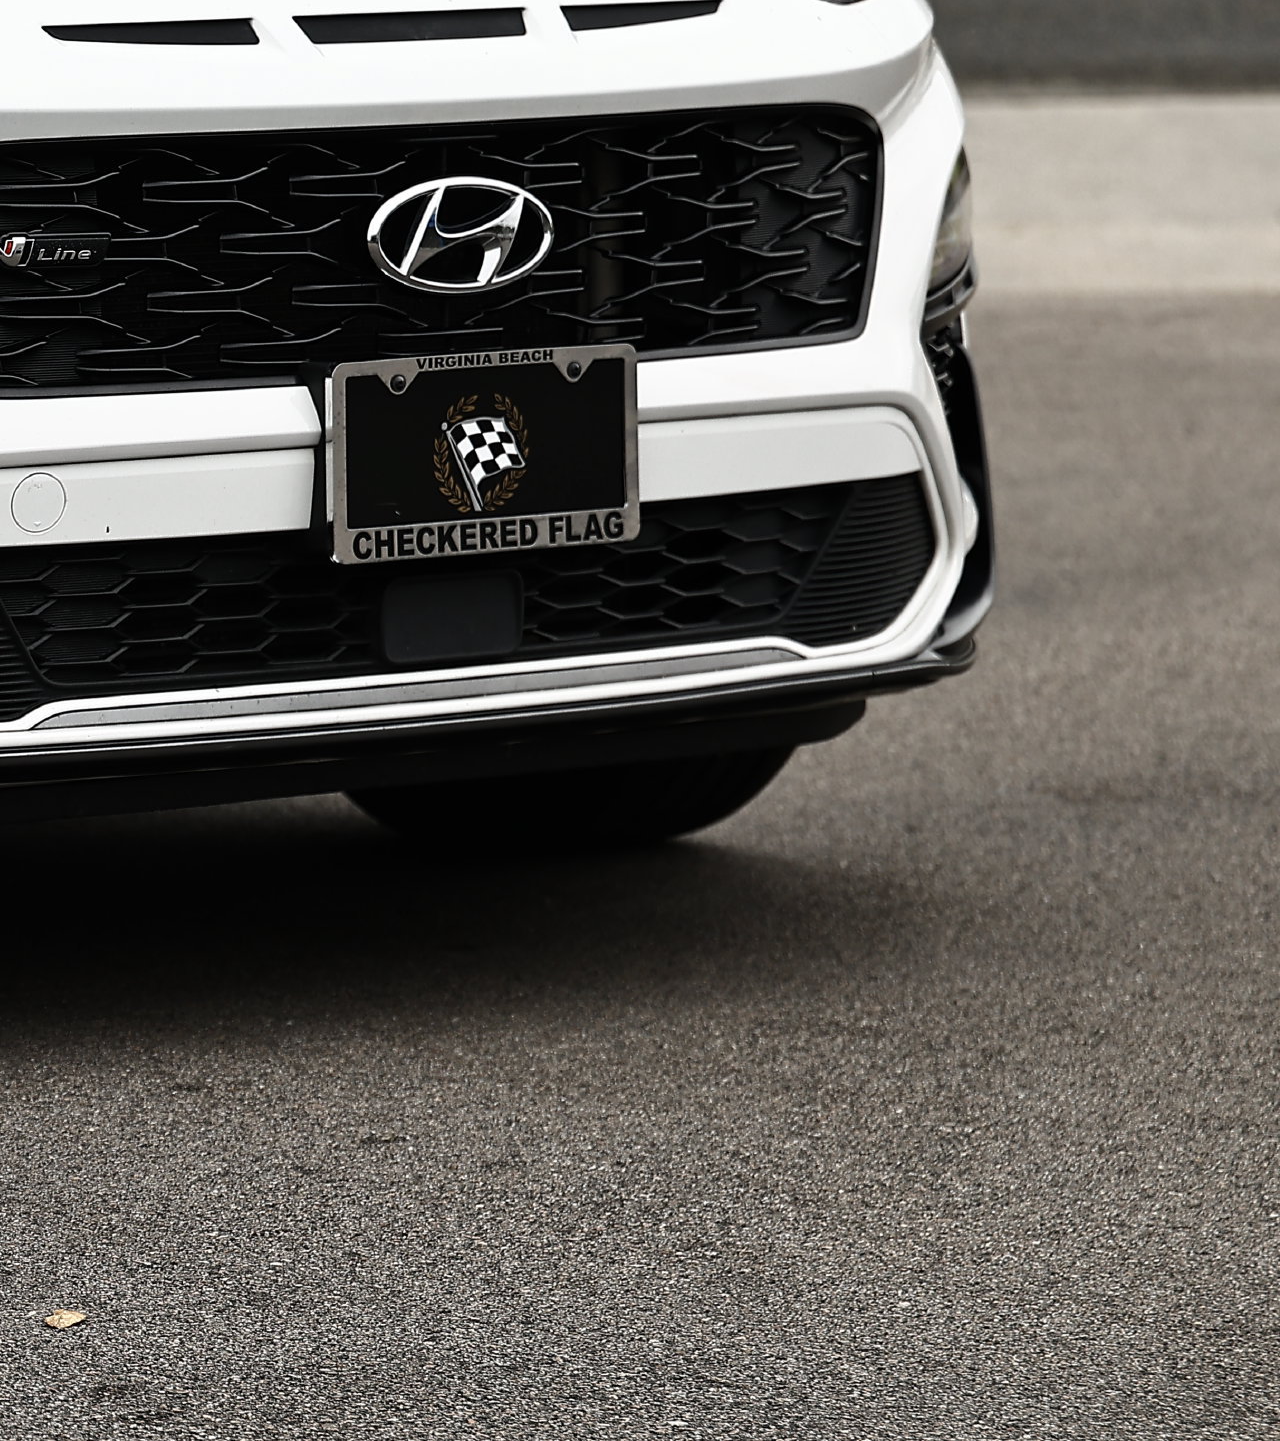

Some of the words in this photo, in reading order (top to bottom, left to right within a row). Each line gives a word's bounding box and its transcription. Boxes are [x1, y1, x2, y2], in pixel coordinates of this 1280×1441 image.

[37, 248, 92, 261] Line
[415, 353, 493, 370] VIRGINIA
[498, 349, 554, 365] BEACH
[352, 518, 539, 560] CHECKERED
[548, 511, 625, 545] FLAG
